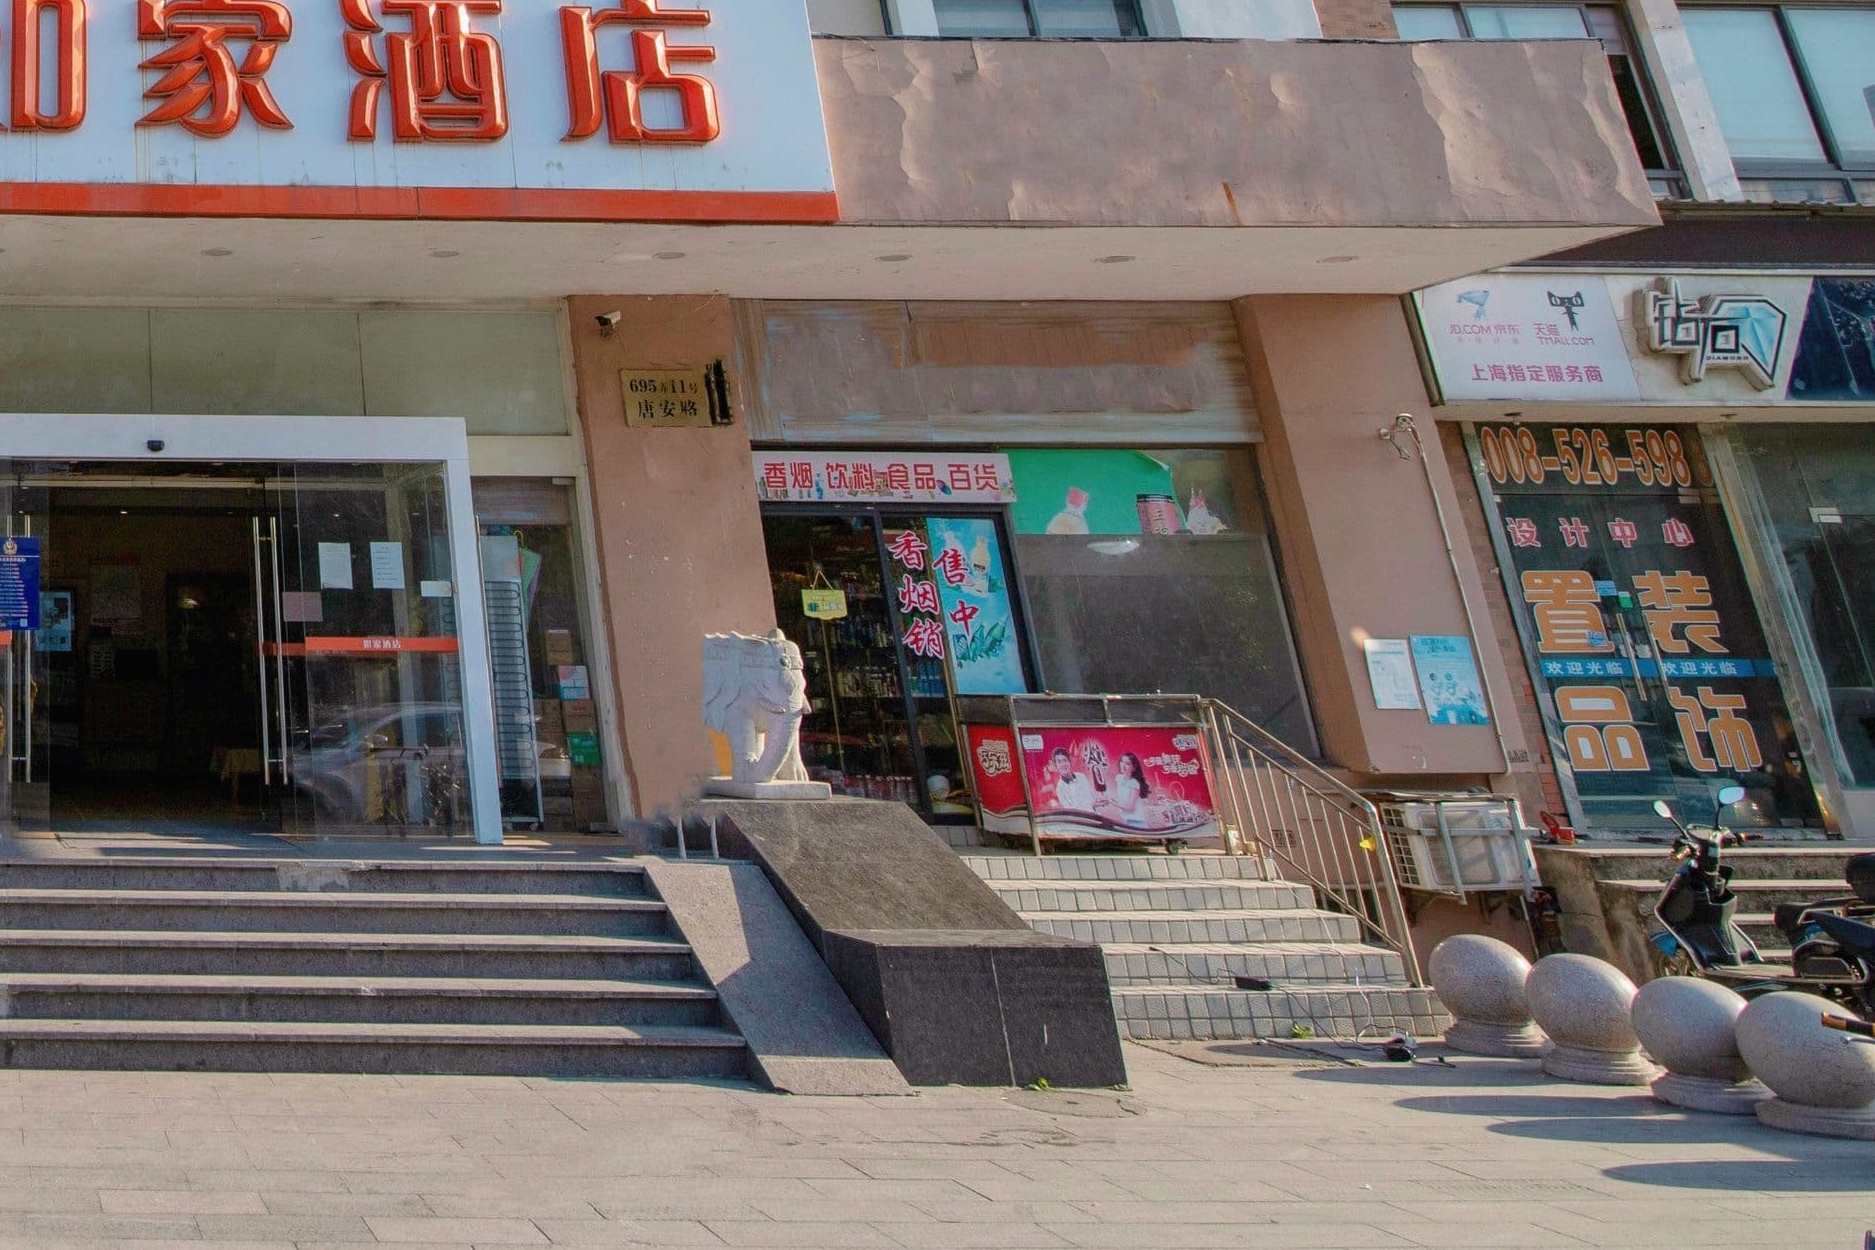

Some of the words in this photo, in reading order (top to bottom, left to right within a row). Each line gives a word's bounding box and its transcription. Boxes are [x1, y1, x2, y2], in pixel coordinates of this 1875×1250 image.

[1449, 324, 1492, 335] JD.COM
[1493, 324, 1521, 335] 京东
[1533, 323, 1560, 336] 天猫
[1471, 364, 1604, 383] 上海指定服务商
[764, 462, 814, 489] 香烟
[825, 462, 874, 490] 饮料
[887, 463, 937, 490] 食品
[947, 463, 1000, 491] 百货
[1506, 517, 1694, 548] 设计中心
[1546, 661, 1625, 676] 欢迎光临
[1661, 661, 1738, 676] 欢迎光临
